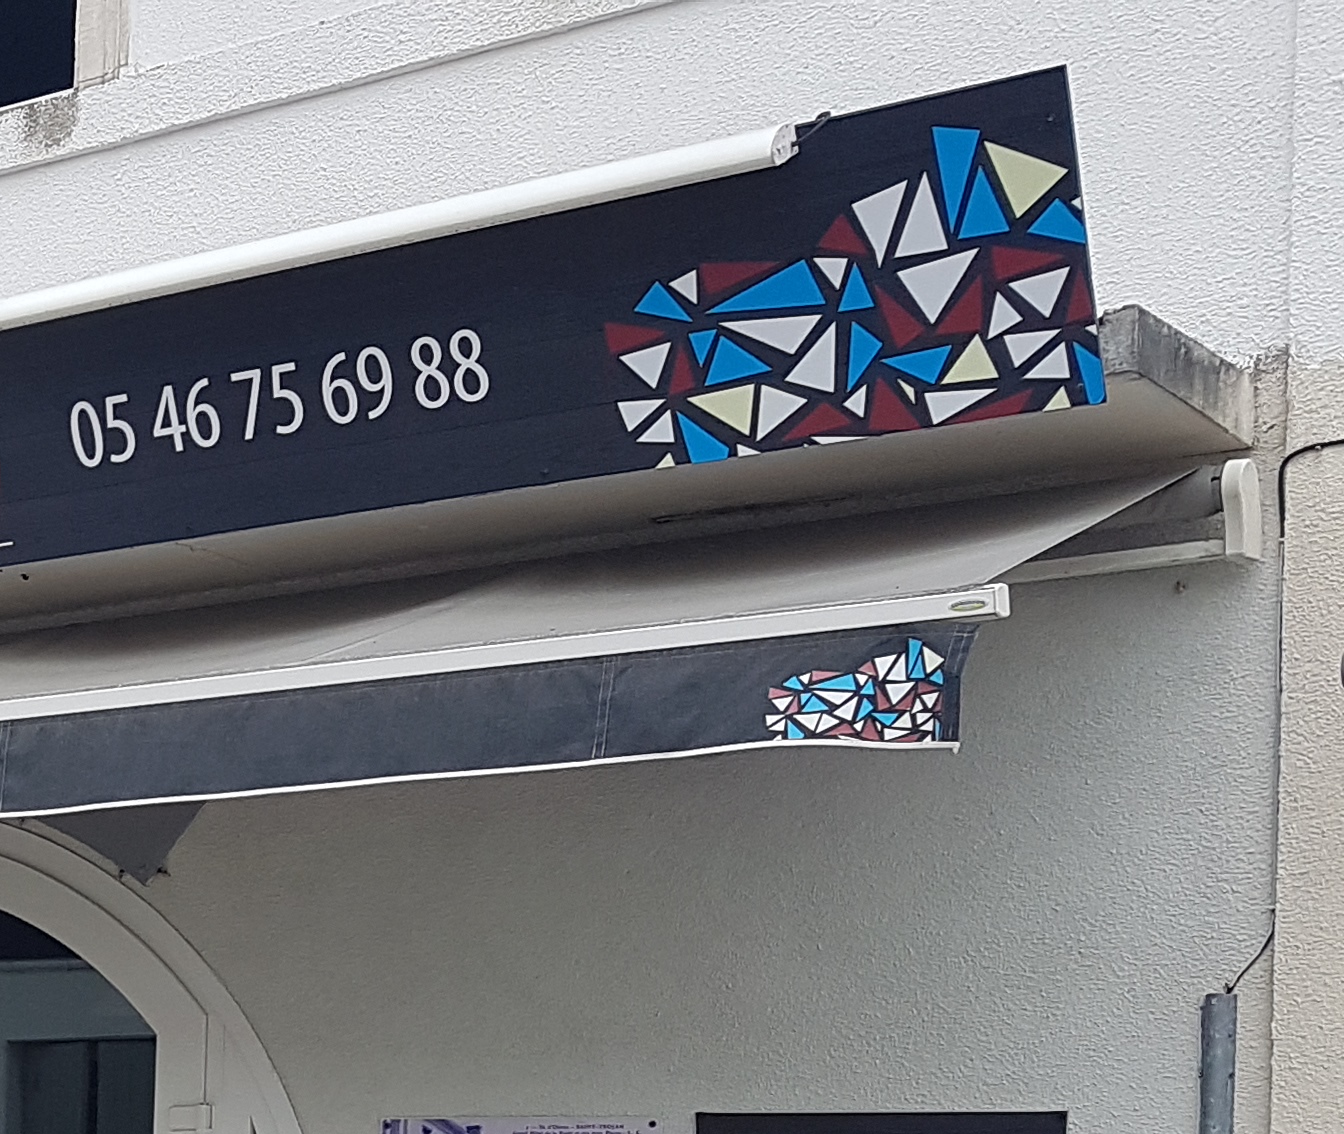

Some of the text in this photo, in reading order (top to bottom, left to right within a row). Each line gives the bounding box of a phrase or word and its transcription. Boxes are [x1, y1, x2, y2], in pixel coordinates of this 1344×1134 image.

[69, 328, 491, 469] 05 46 75 69 88
